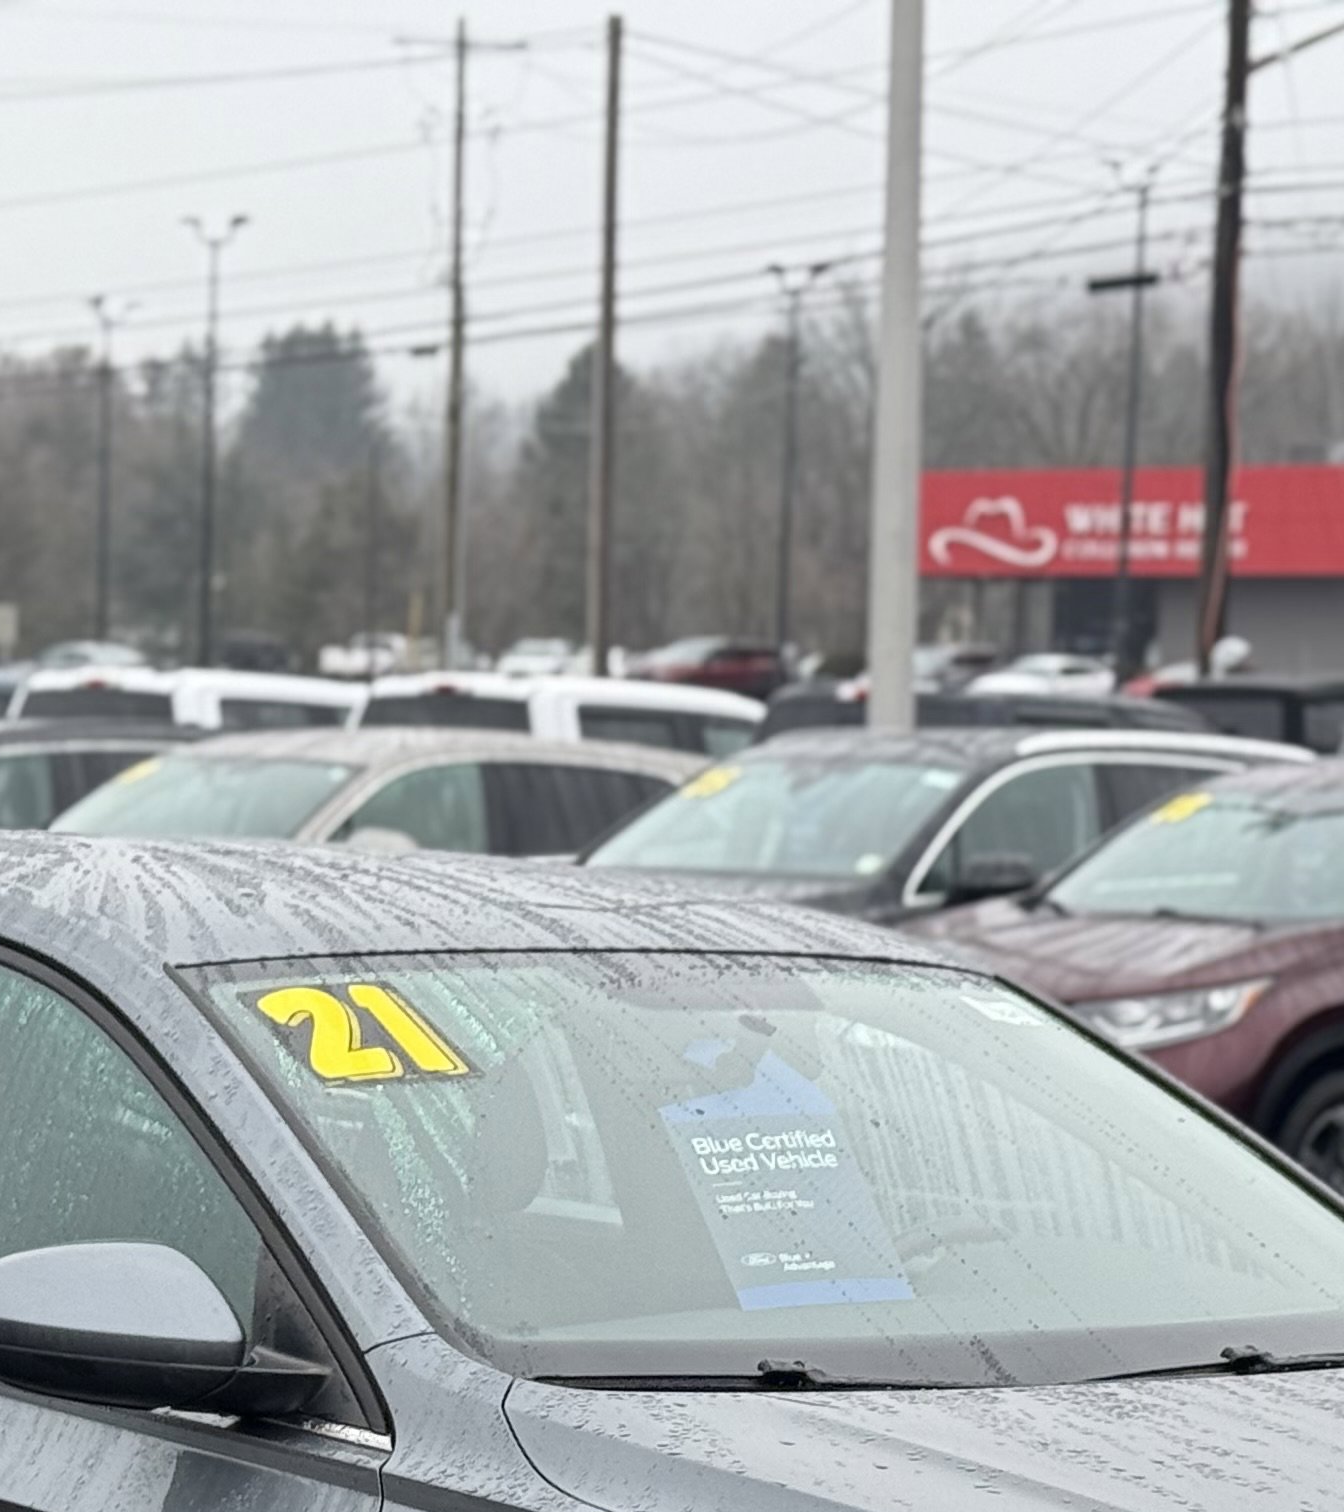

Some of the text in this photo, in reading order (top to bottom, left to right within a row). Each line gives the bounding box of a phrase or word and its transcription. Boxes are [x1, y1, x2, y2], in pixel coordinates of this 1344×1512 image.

[1063, 502, 1171, 534] WHTE
[256, 984, 471, 1081] 21
[691, 1129, 836, 1154] Blue Certified
[699, 1149, 838, 1175] Used Vehicle
